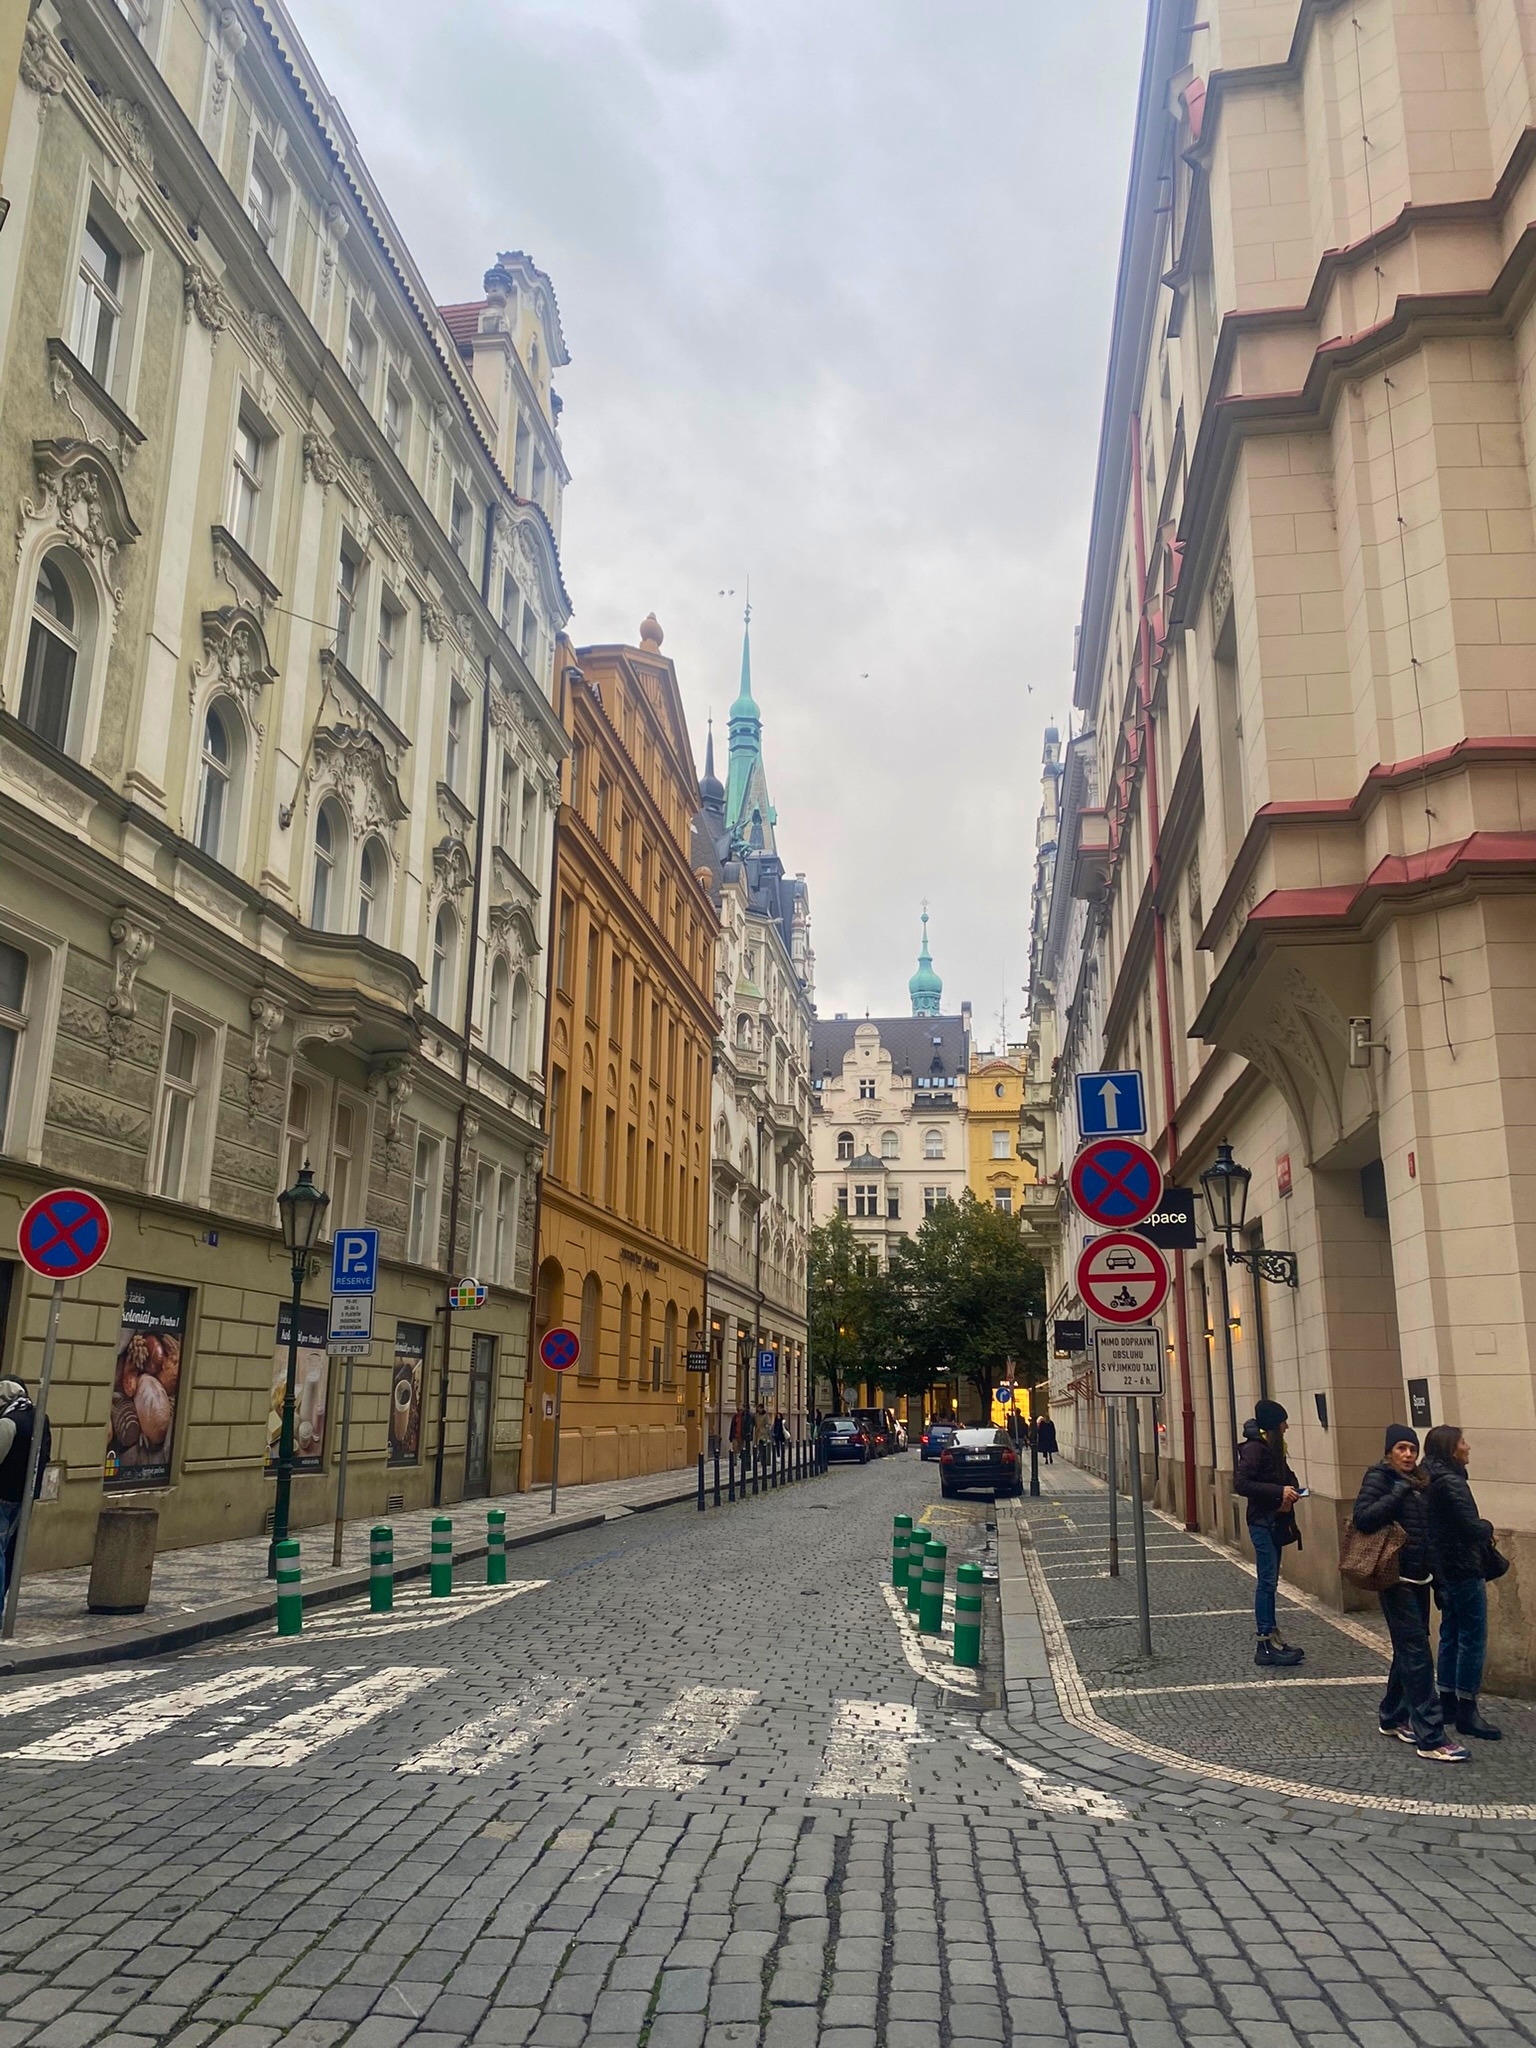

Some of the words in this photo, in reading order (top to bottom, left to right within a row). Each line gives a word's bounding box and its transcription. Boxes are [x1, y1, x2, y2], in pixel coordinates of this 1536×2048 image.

[342, 1237, 368, 1273] P
[1100, 1337, 1120, 1346] MIMO
[1120, 1336, 1155, 1346] DOPRAVNÍ
[1112, 1350, 1144, 1359] OBSLUHU
[1101, 1363, 1106, 1372] S
[1107, 1361, 1141, 1372] VÝJIMKOU
[1142, 1363, 1157, 1372] TAXI
[1124, 1376, 1132, 1385] 22
[1140, 1376, 1145, 1385] 6
